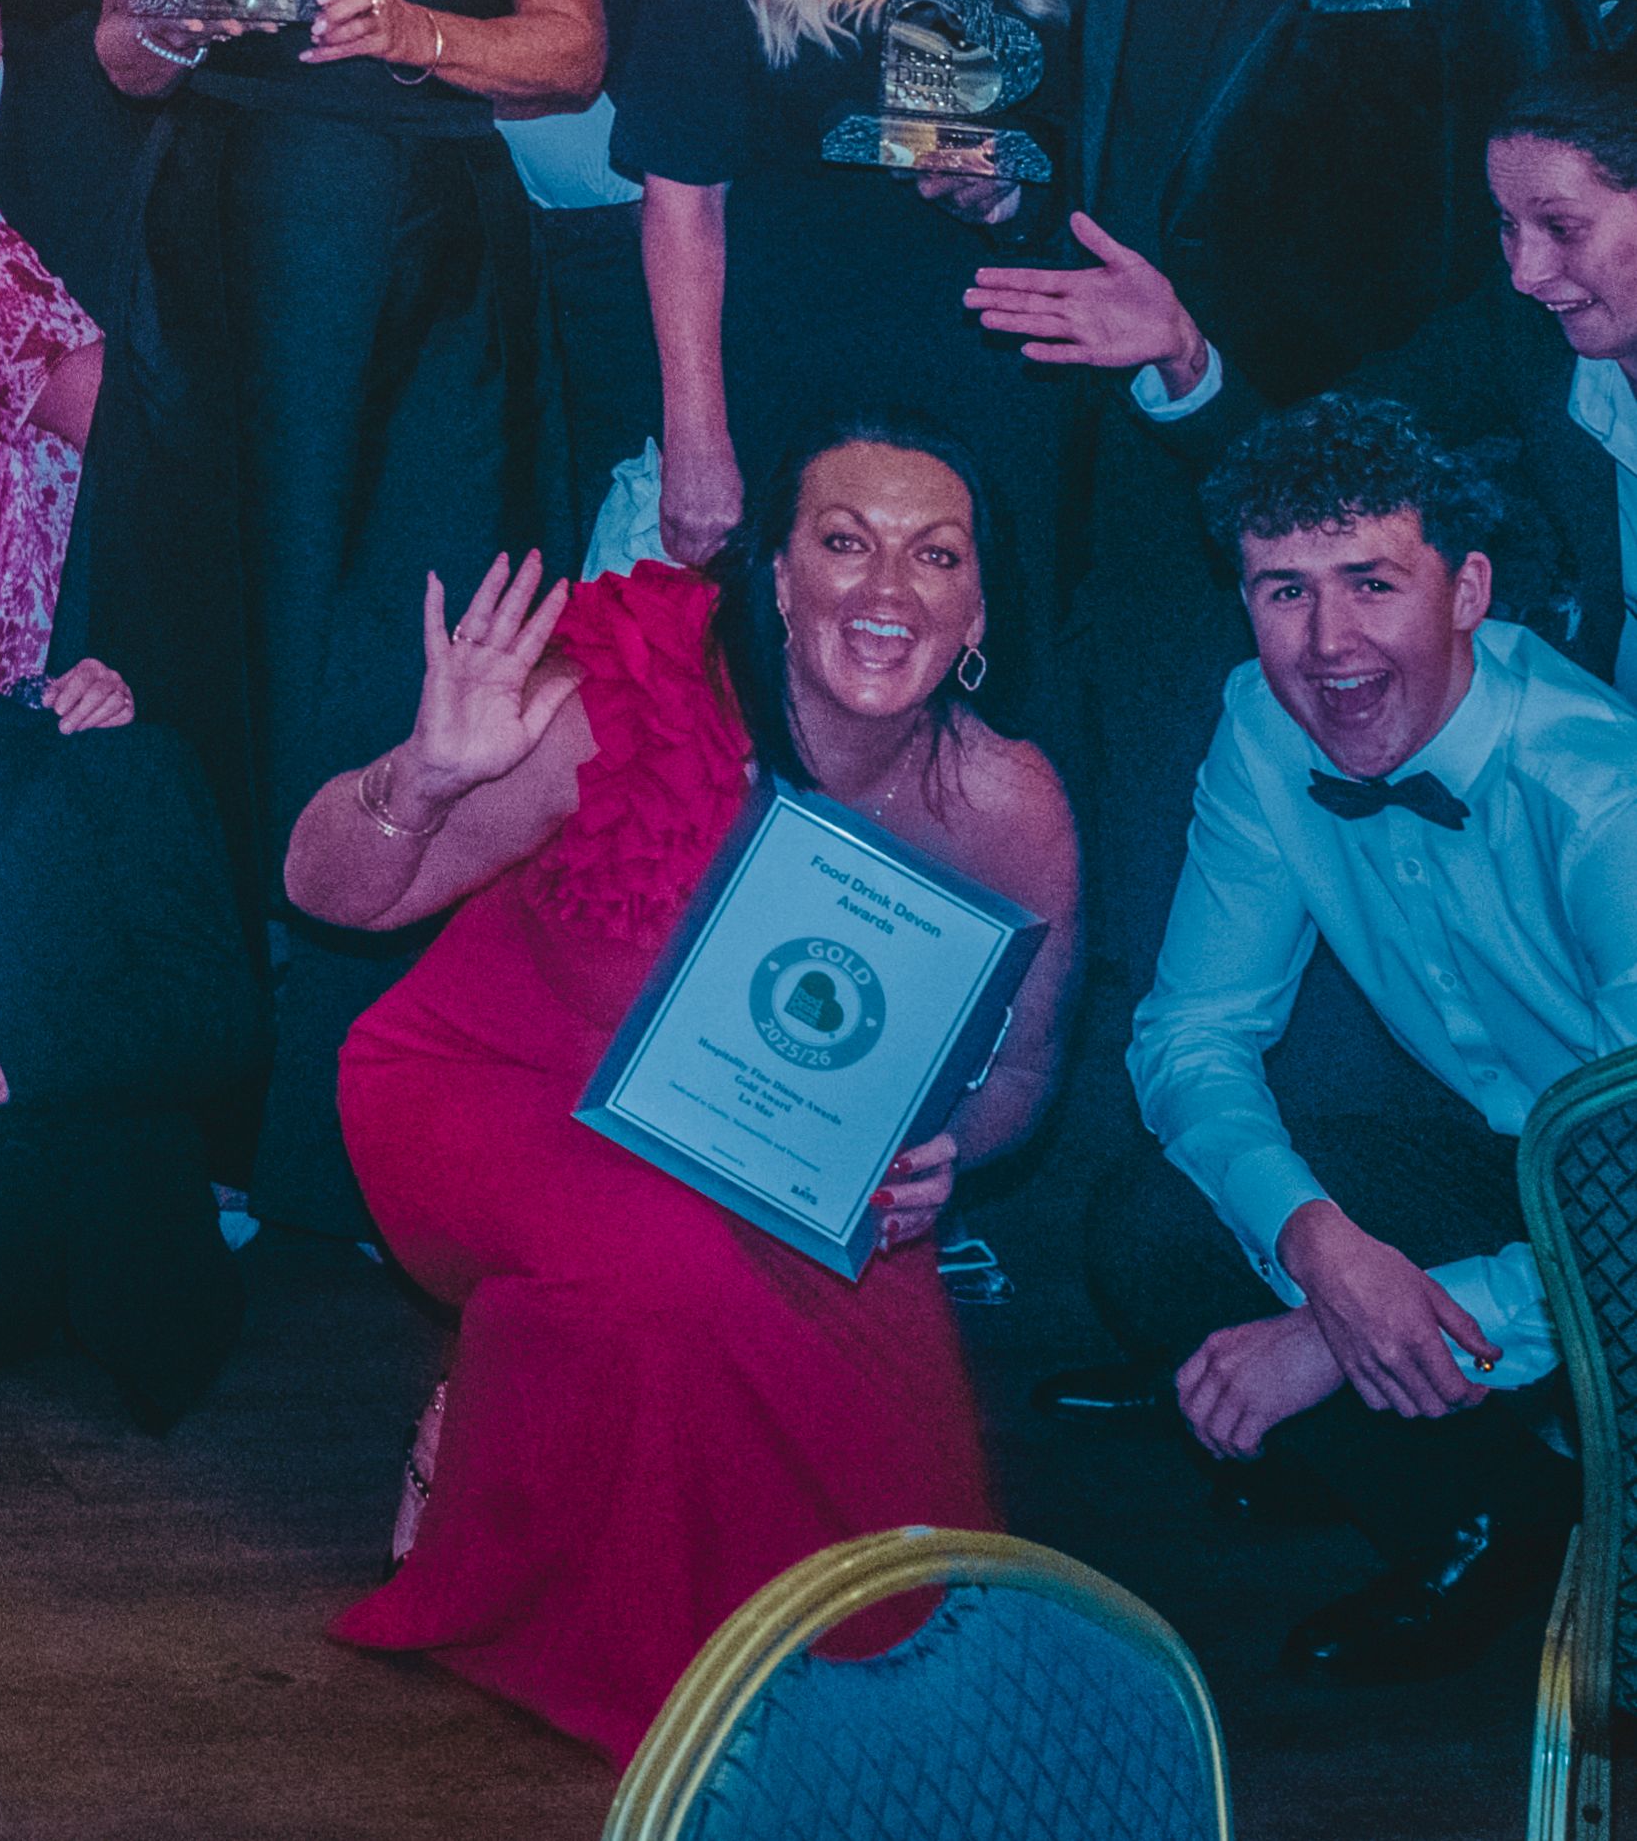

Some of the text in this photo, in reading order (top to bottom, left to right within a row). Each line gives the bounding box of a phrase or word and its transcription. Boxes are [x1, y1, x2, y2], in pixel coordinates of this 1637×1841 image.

[809, 853, 942, 939] Food Drink Devon
[835, 894, 895, 935] Awards
